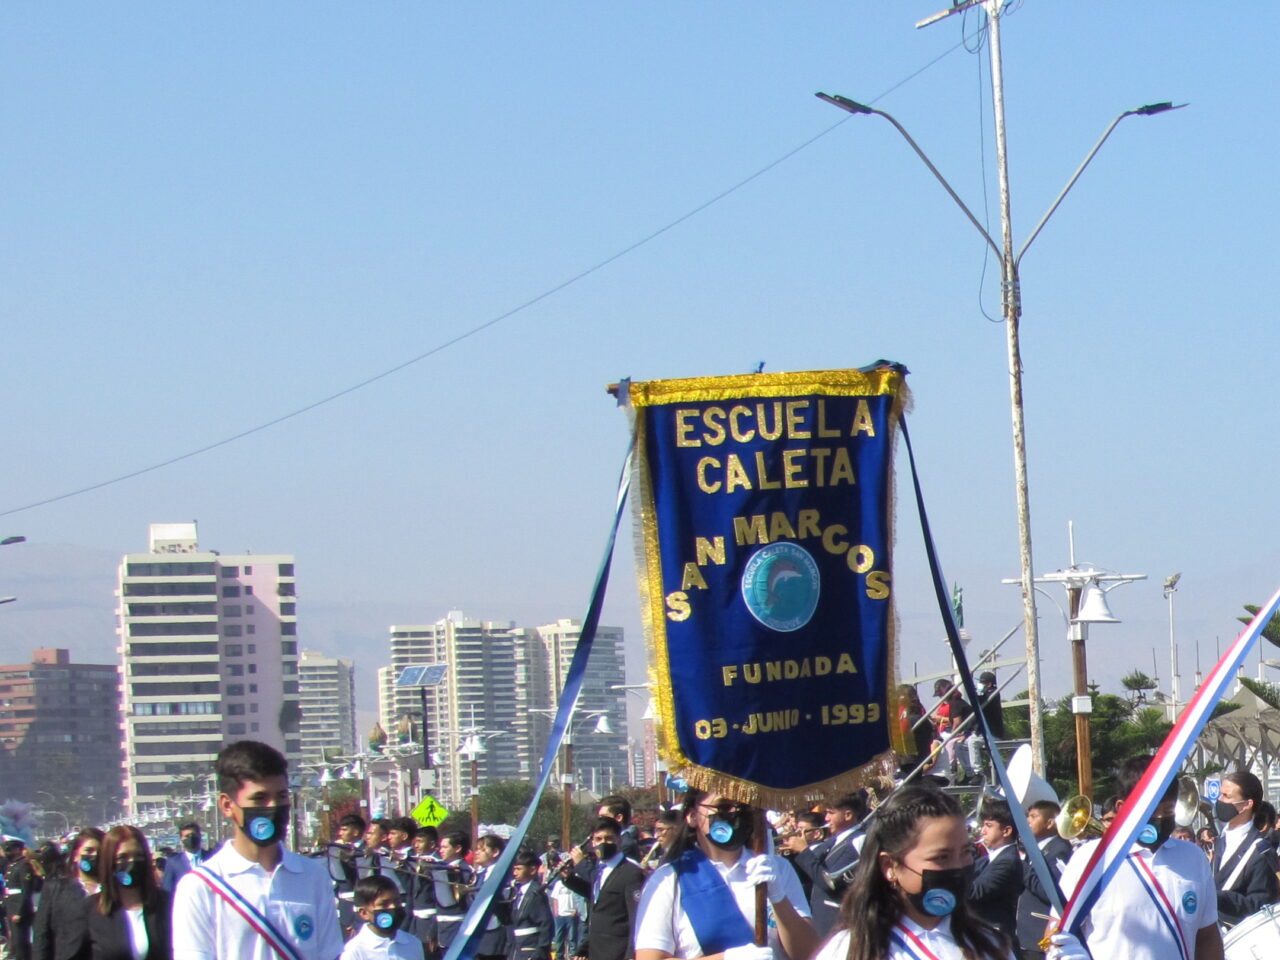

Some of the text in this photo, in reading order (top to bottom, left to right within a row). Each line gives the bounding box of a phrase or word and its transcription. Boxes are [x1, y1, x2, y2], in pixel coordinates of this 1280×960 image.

[675, 399, 876, 448] ESCUELA
[696, 447, 856, 494] CALETA
[665, 509, 890, 622] SAN MARCOS
[722, 653, 858, 686] FUNDADA
[694, 703, 880, 740] 03 JUNIO 1993
